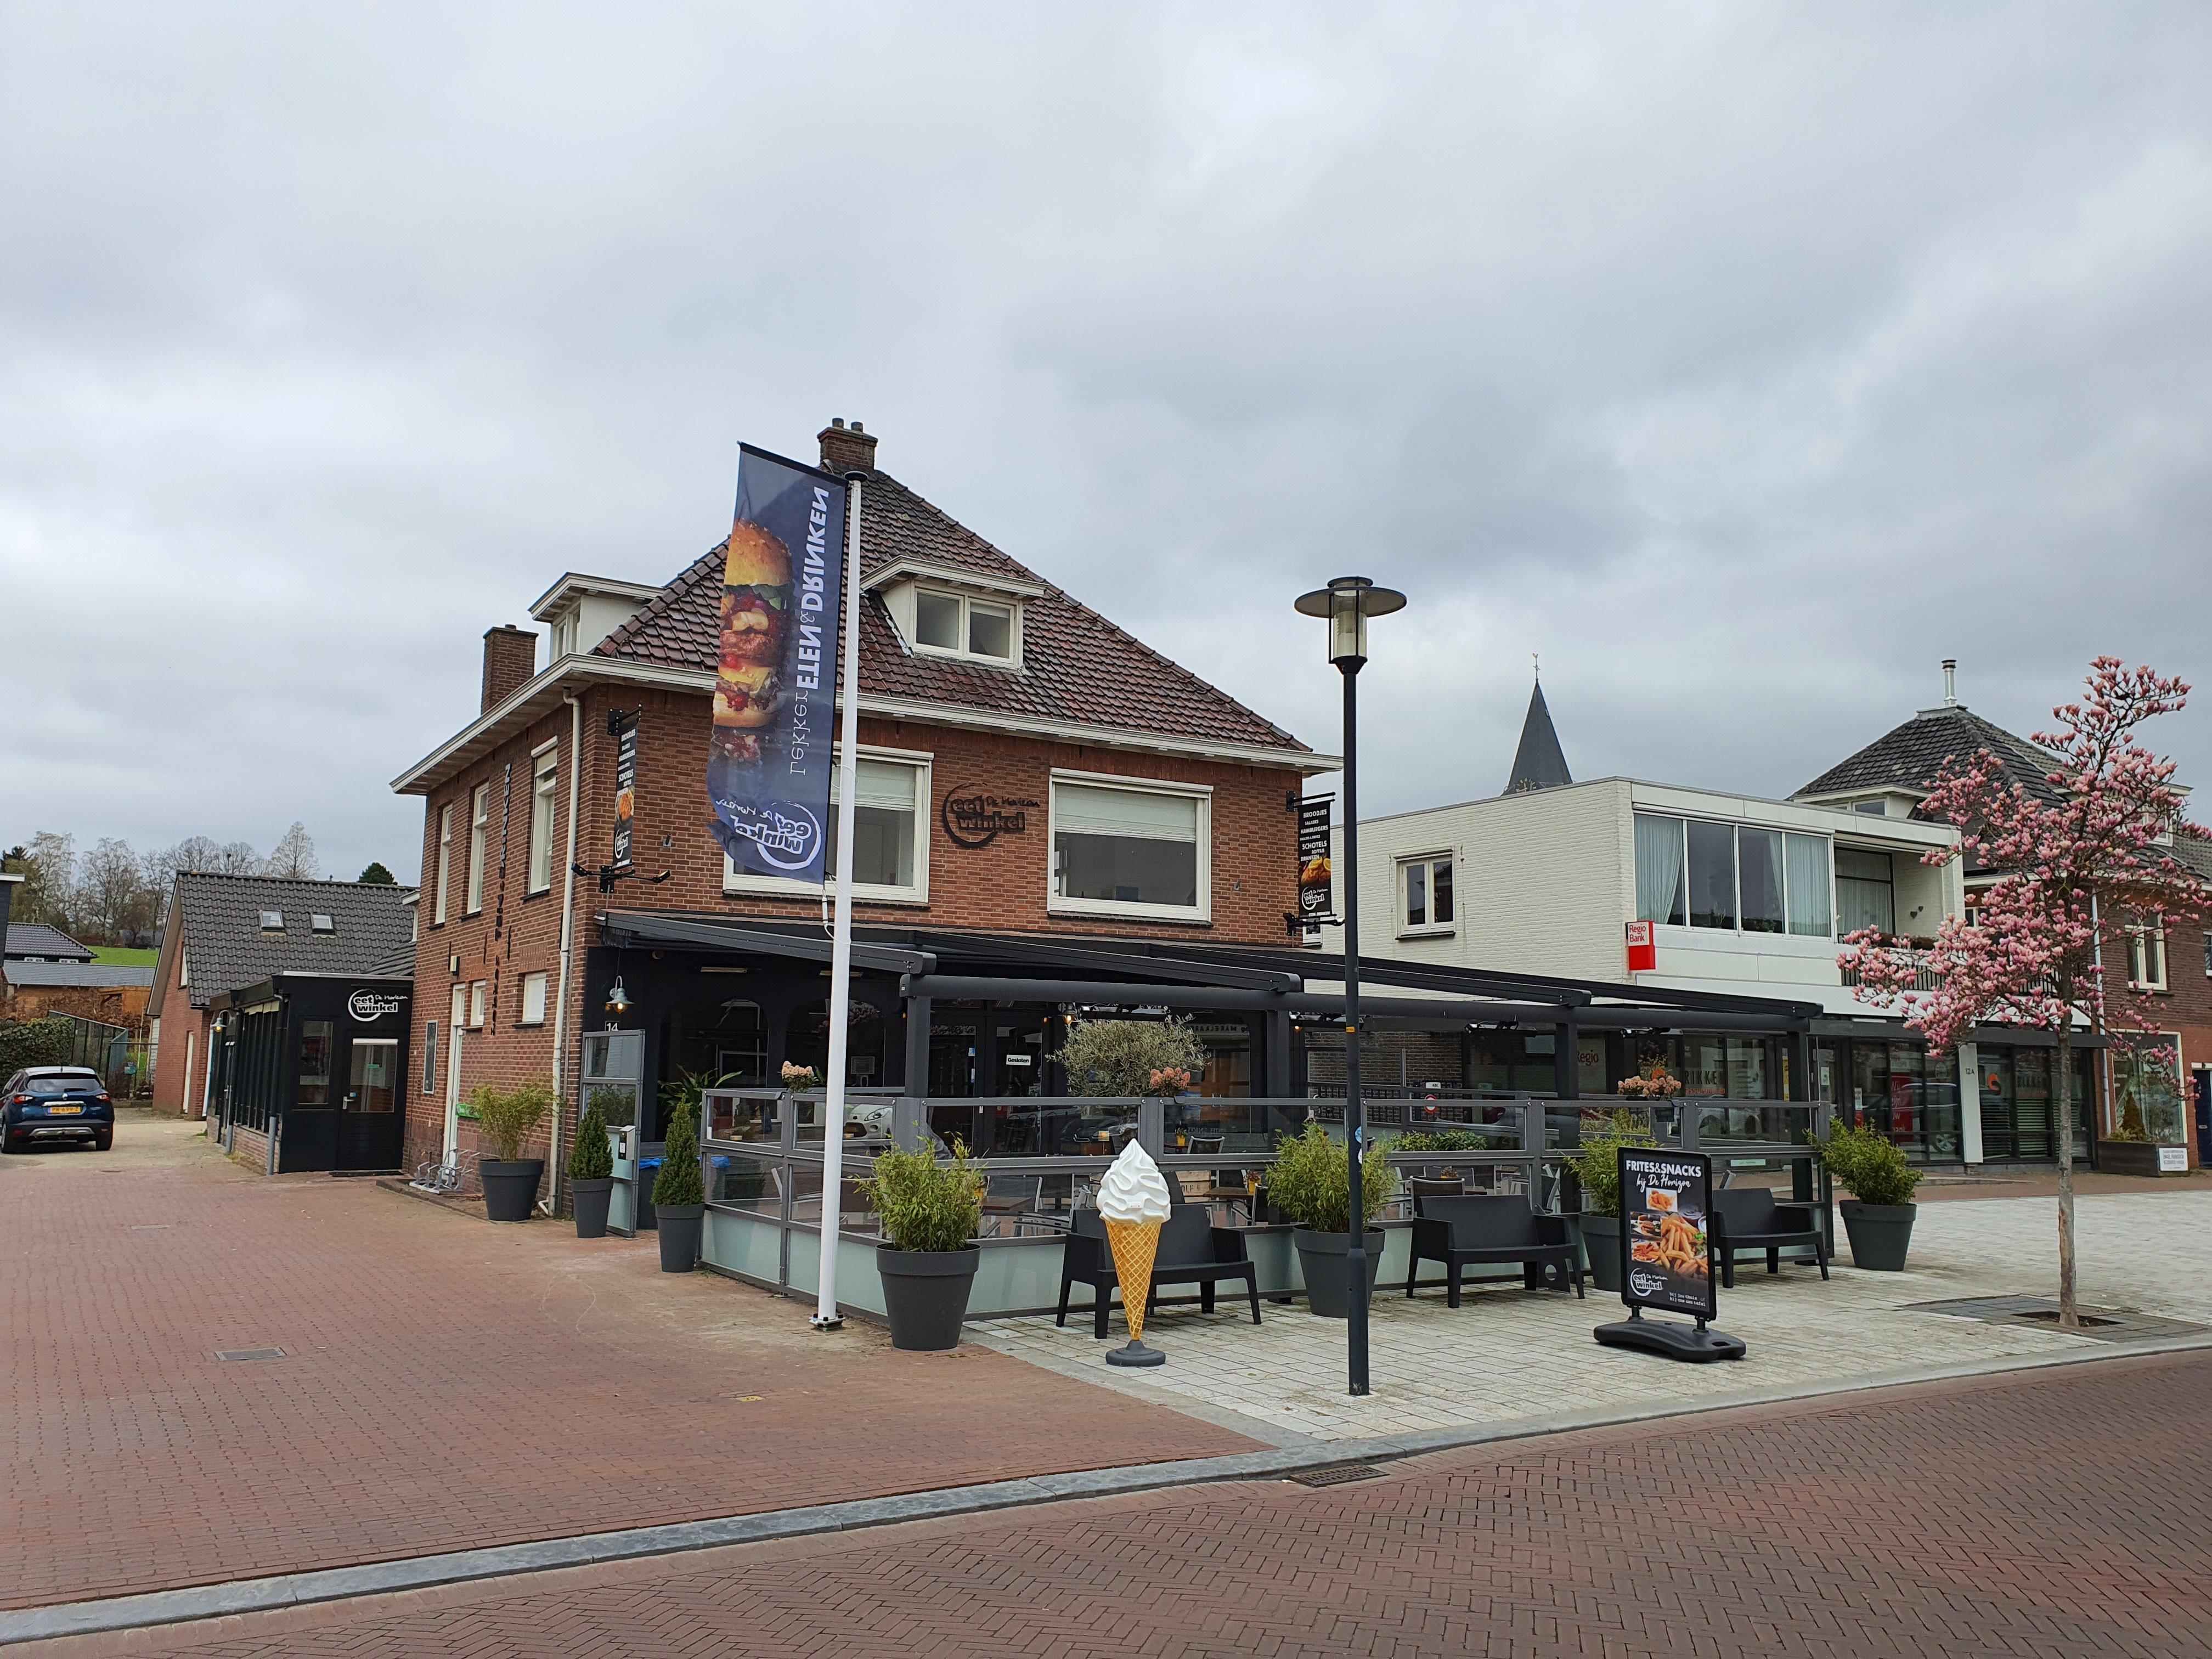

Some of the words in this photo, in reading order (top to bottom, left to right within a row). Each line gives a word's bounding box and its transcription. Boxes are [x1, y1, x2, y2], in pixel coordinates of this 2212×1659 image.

[1303, 809, 1327, 819] BROODJES
[958, 811, 1025, 831] winkel
[1300, 825, 1328, 834] HAMBURGERS
[1302, 840, 1327, 850] SCHOTELS
[1306, 894, 1324, 904] winkel
[1629, 924, 1646, 934] Regio
[1630, 934, 1645, 942] Bank
[354, 995, 374, 1004] eet
[357, 1003, 398, 1012] winkel
[606, 1022, 619, 1031] 14
[1636, 1173, 1646, 1193] bij
[1647, 1174, 1659, 1185] De
[1661, 1174, 1691, 1193] Horizon
[1637, 1280, 1662, 1290] winkel
